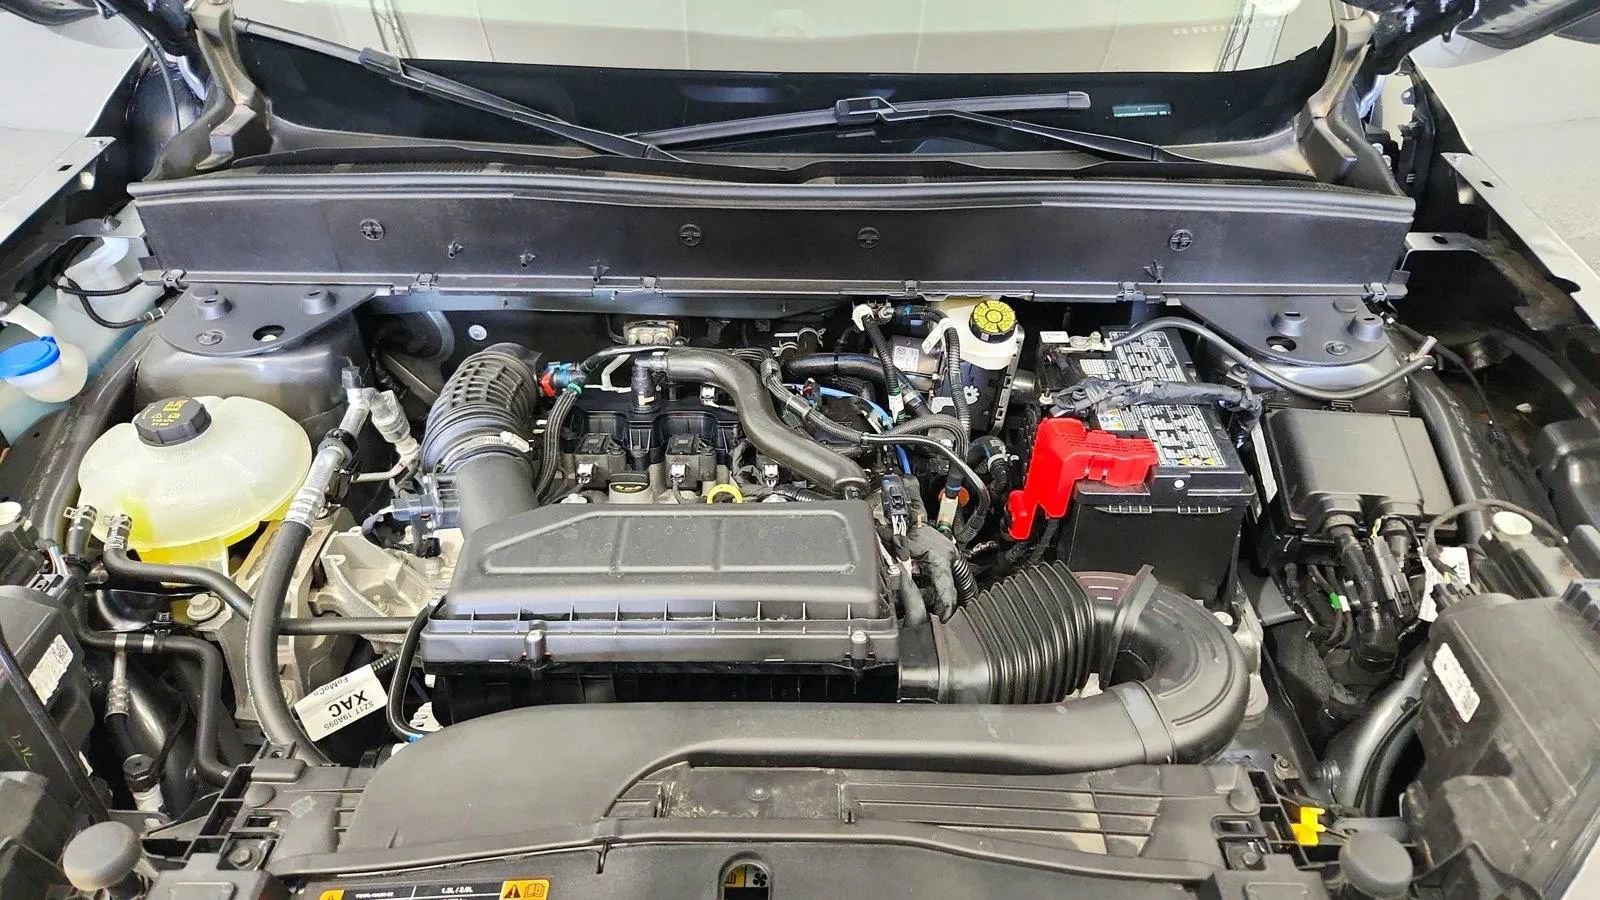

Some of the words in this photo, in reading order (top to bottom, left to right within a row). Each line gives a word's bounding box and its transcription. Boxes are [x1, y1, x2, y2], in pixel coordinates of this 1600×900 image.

[313, 676, 349, 696] FoMoCo
[328, 690, 368, 717] XAC
[323, 712, 352, 730] 19A095
